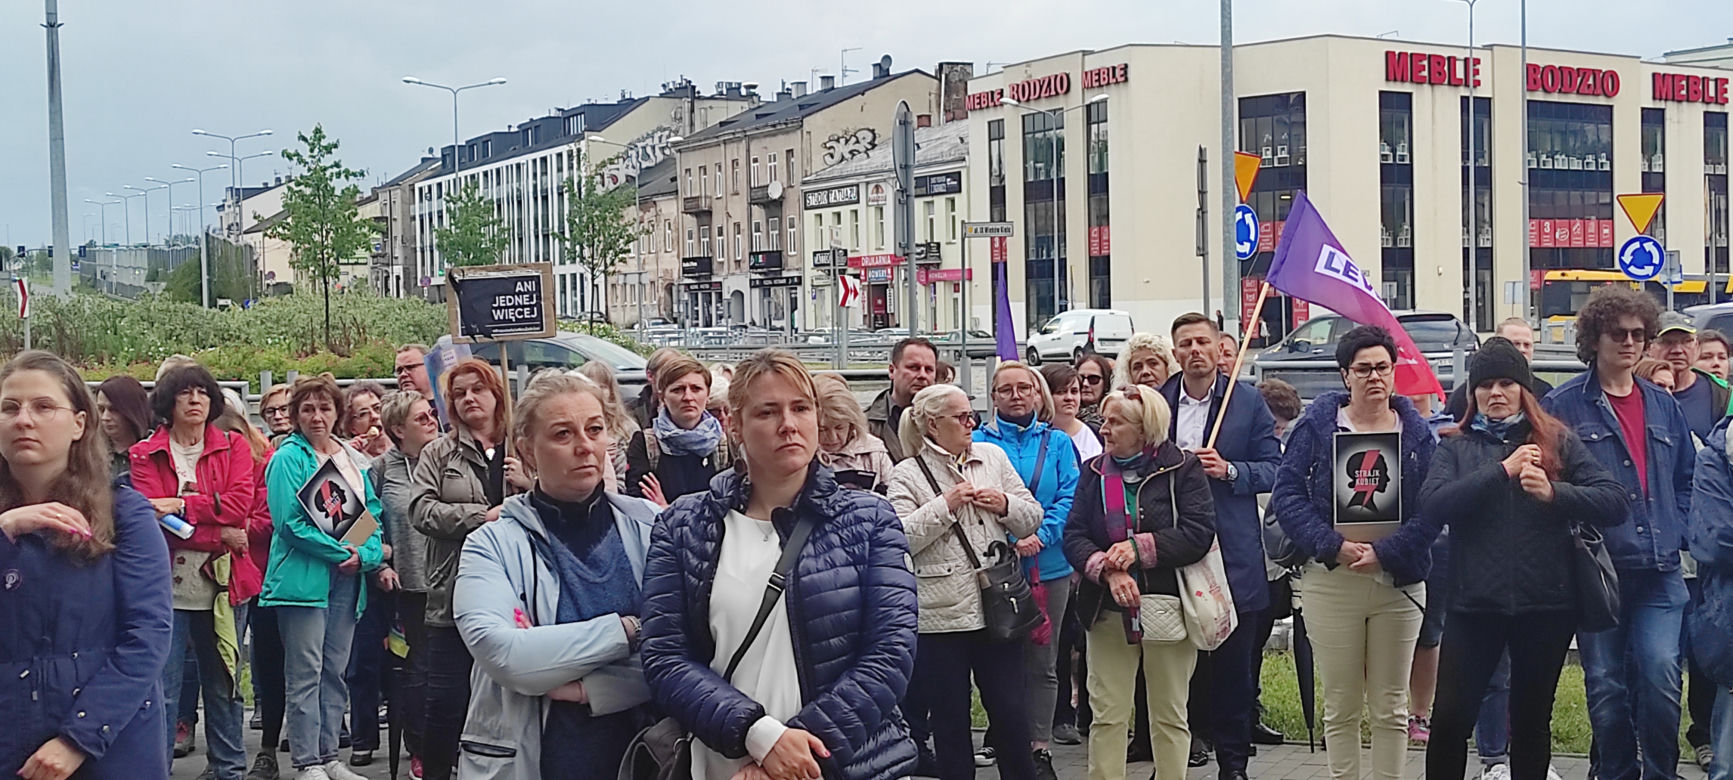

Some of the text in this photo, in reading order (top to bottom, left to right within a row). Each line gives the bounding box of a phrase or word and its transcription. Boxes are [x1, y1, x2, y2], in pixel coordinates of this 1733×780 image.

[1385, 51, 1729, 104] MEBLE BODZIO MEBLE
[965, 63, 1129, 111] MEBLE BODZIO MEBLE
[861, 255, 892, 267] DRUKARNIA
[515, 281, 536, 292] ANI
[492, 294, 537, 307] JEDNEJ
[492, 307, 538, 322] WIĘCEJ
[1354, 469, 1380, 478] STRAJK
